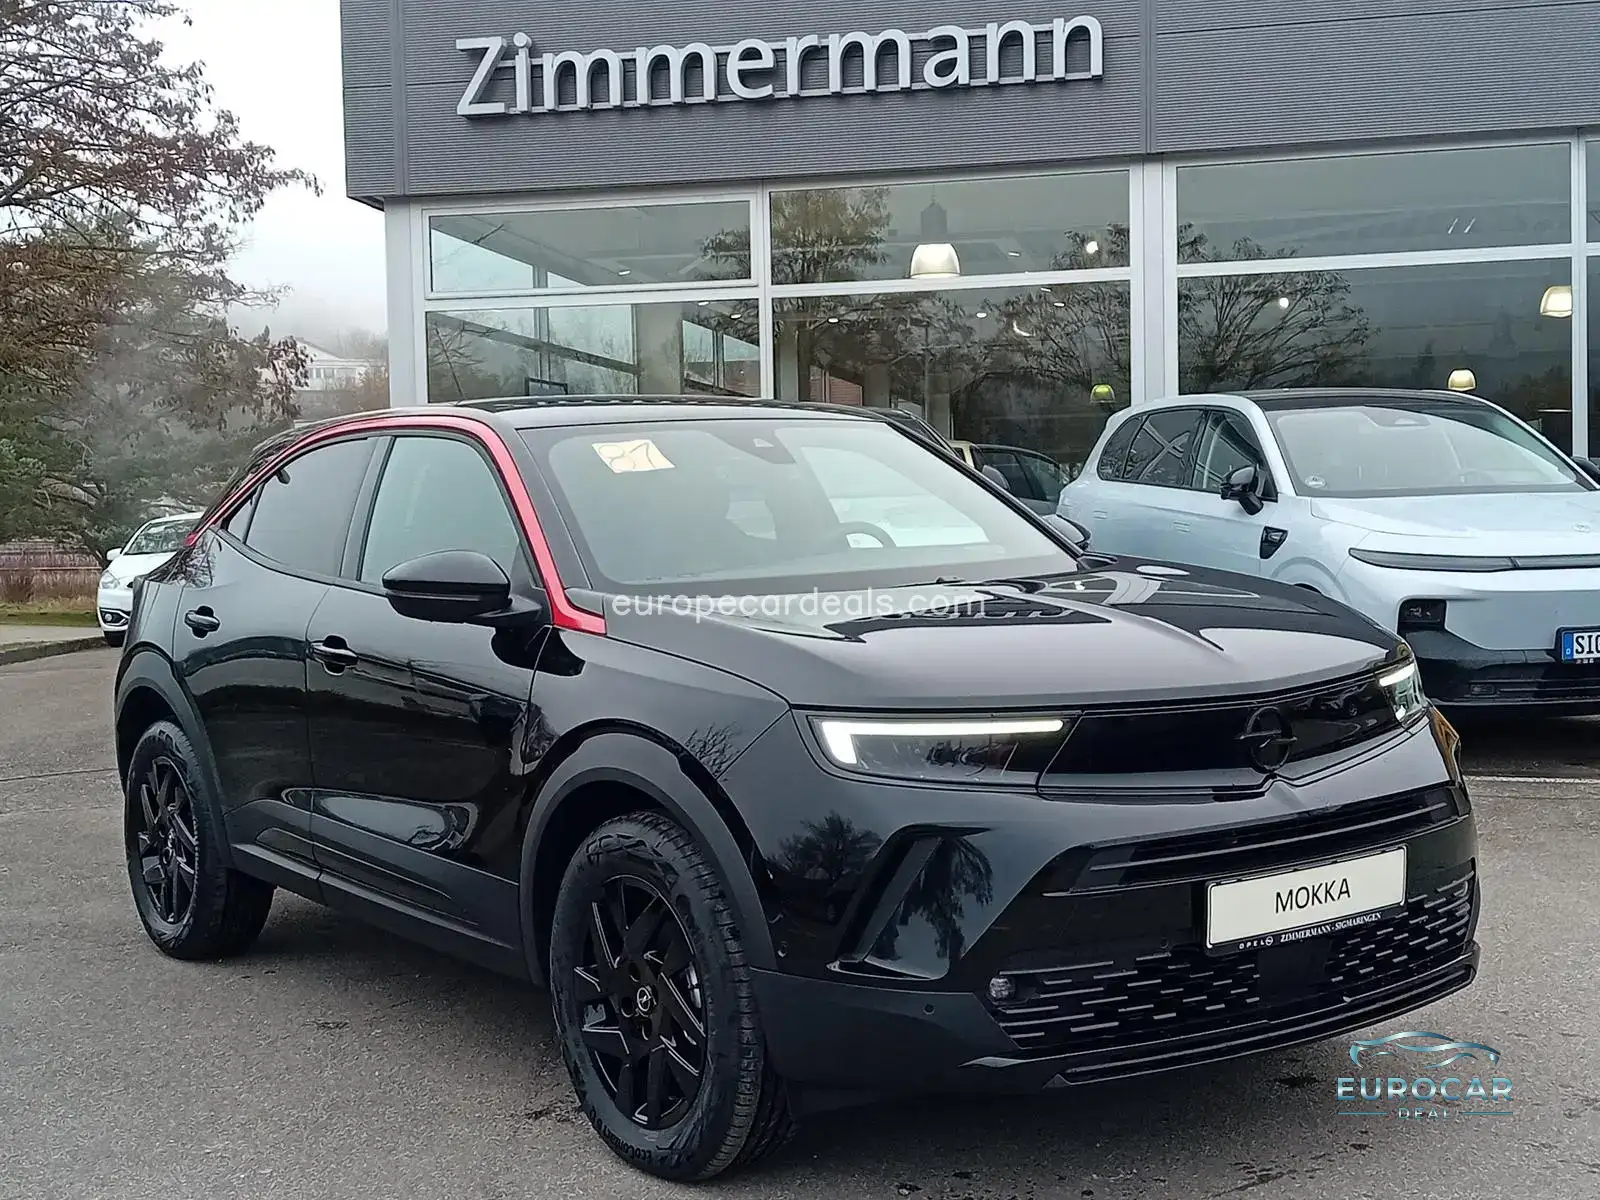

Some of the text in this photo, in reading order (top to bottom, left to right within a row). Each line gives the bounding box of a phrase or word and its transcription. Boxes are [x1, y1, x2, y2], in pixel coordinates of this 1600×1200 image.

[456, 14, 1103, 116] Zimmermann
[1275, 877, 1351, 913] MOKKA
[1238, 938, 1265, 950] OPEL
